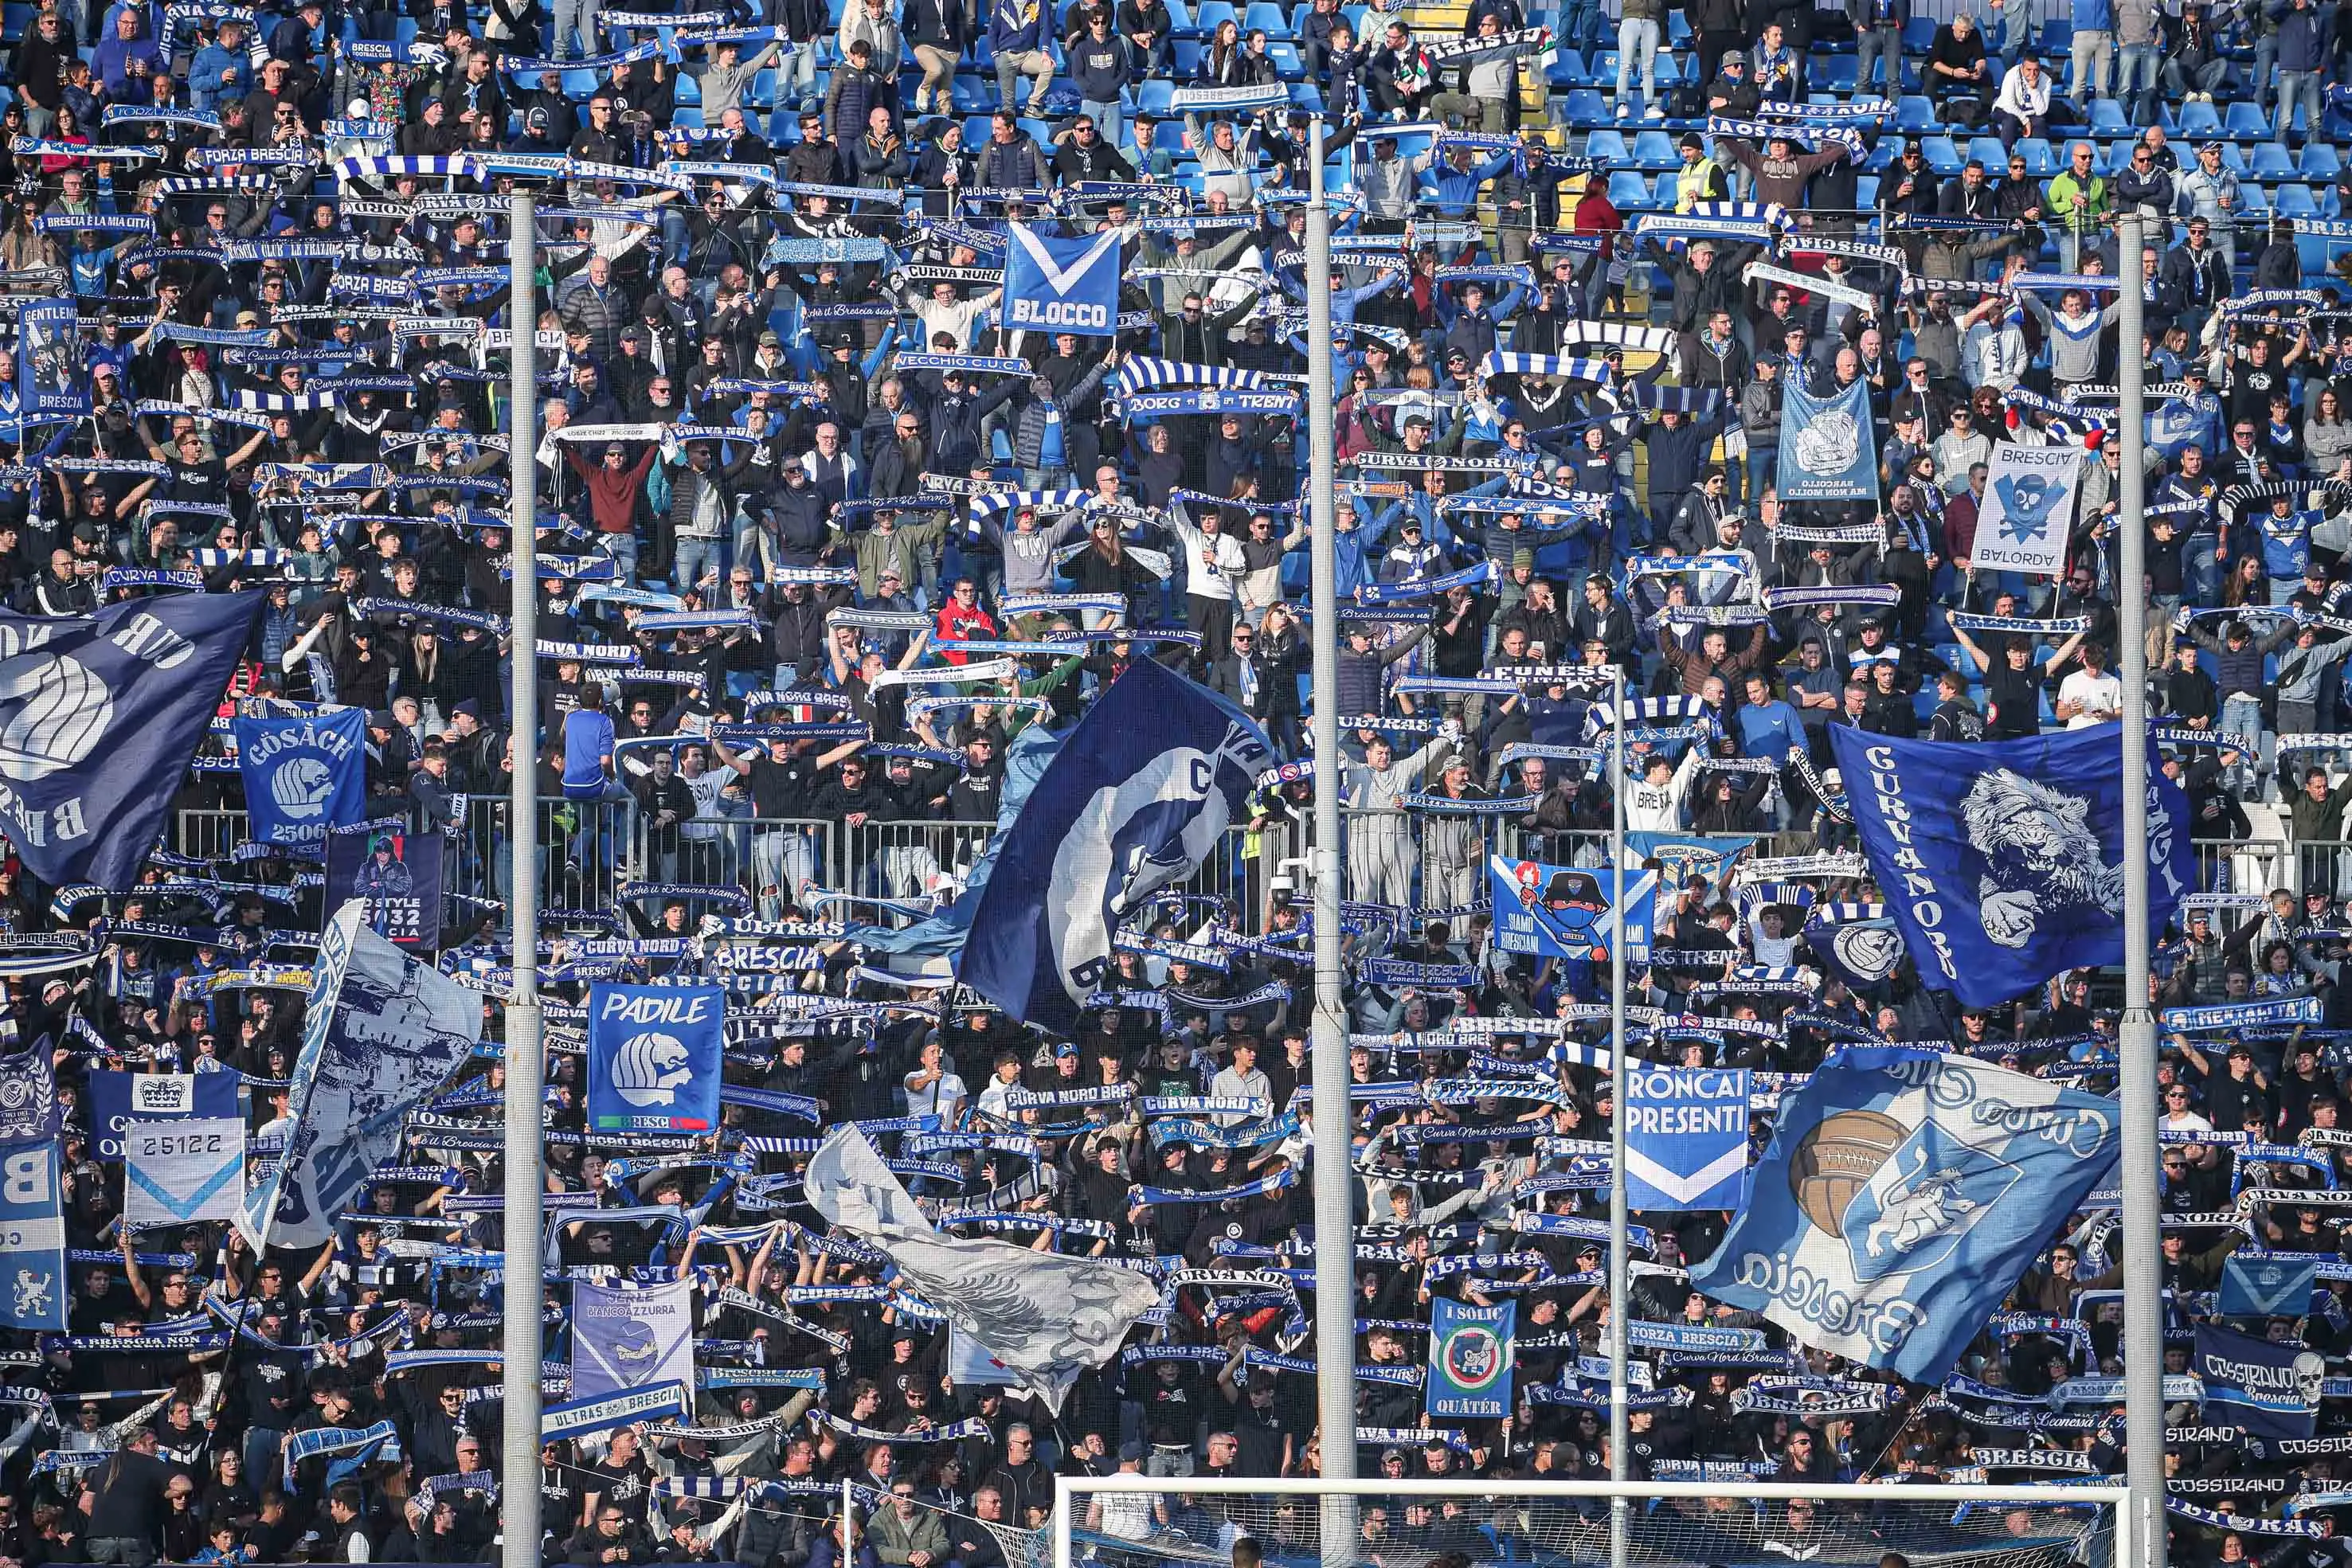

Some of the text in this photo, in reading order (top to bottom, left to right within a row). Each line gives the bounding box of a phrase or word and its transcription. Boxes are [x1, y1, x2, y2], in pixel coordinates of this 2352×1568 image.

[618, 11, 712, 25] BRESCIA
[717, 27, 759, 36] BRESCIA
[1423, 33, 1443, 41] FILA
[352, 44, 390, 53] BRESCIA
[1468, 132, 1511, 141] BRESCIA
[205, 149, 303, 163] FORZA BRESCIA
[584, 164, 688, 189] BRESCIA
[49, 216, 124, 228] BRESCIA LA MIA
[1146, 217, 1253, 228] FORZA BRESCIA
[154, 247, 194, 259] Brescia
[1794, 237, 1898, 258] BRESCIA
[909, 267, 1003, 280] CURVA NORD
[2265, 291, 2293, 302] NORD
[1015, 299, 1106, 326] BLOCCO
[249, 349, 352, 361] Curva Nord Brescia
[900, 356, 967, 366] VECCHIO
[444, 366, 475, 377] Curva
[313, 376, 414, 389] Curva Nord Brescia
[40, 395, 83, 409] BRESCIA
[1132, 398, 1180, 412] BORG
[2008, 390, 2080, 418] CURVA NORD
[2002, 450, 2072, 466] BRESCIA
[397, 475, 498, 490] Curva Nord Brescia
[1981, 549, 2054, 565] BALORDA
[111, 570, 157, 582] CURVA
[416, 603, 441, 615] Nord
[444, 607, 483, 622] Brescia
[1342, 609, 1383, 619] Brescia
[1674, 605, 1708, 616] FORZA
[1956, 618, 2043, 630] BRESCIA
[584, 644, 632, 658] NORD
[1339, 717, 1430, 731] ULTRAS
[249, 722, 353, 765] GÖSÀCH
[273, 823, 325, 841] 2506
[664, 886, 736, 900] Brescia siamo
[539, 909, 569, 918] Nord
[734, 918, 844, 936] ULTRAS
[1509, 914, 1533, 933] SIAMO
[588, 939, 680, 953] CURVA NORD
[1501, 933, 1539, 953] BRESCIANI
[718, 946, 823, 970] BRESCIA
[1375, 960, 1471, 976] FORZA BRESCIA
[603, 992, 710, 1024] PADILE
[1462, 1017, 1564, 1032] BRESCIA
[1418, 1033, 1454, 1046] NORD
[1442, 1081, 1492, 1092] BRESCIA
[1628, 1071, 1743, 1099] RONCAI
[441, 1095, 474, 1105] UNION
[1010, 1089, 1098, 1107] CURVA NORD
[1146, 1097, 1249, 1111] CURVA NORD
[900, 1120, 922, 1129] CLUB
[1626, 1107, 1743, 1133] PRESENTI
[1423, 1124, 1530, 1140] Curva Nord Brescia
[2197, 1131, 2247, 1144] NORD
[144, 1135, 221, 1155] 25122
[443, 1136, 491, 1149] Brescia
[2274, 1252, 2320, 1261] BRESCIA
[588, 1305, 676, 1317] BIANCOAZZURRA
[452, 1314, 502, 1328] Leonessa
[88, 1337, 160, 1346] BRESCIA
[1633, 1328, 1738, 1347] FORZA BRESCIA
[703, 1342, 742, 1353] Brescia
[1673, 1351, 1785, 1364] Curva Nord Brescia
[2205, 1355, 2292, 1388] COSSIRANO
[1627, 1394, 1667, 1405] Brescia
[2244, 1385, 2300, 1406] Brescia
[555, 1388, 680, 1427] ULTRAS BRESCIA
[2037, 1414, 2096, 1429] Leonessa
[1653, 1460, 1702, 1472] CURVA
[1977, 1450, 2091, 1468] BRESCIA
[2169, 1479, 2284, 1492] COSSIRANO
